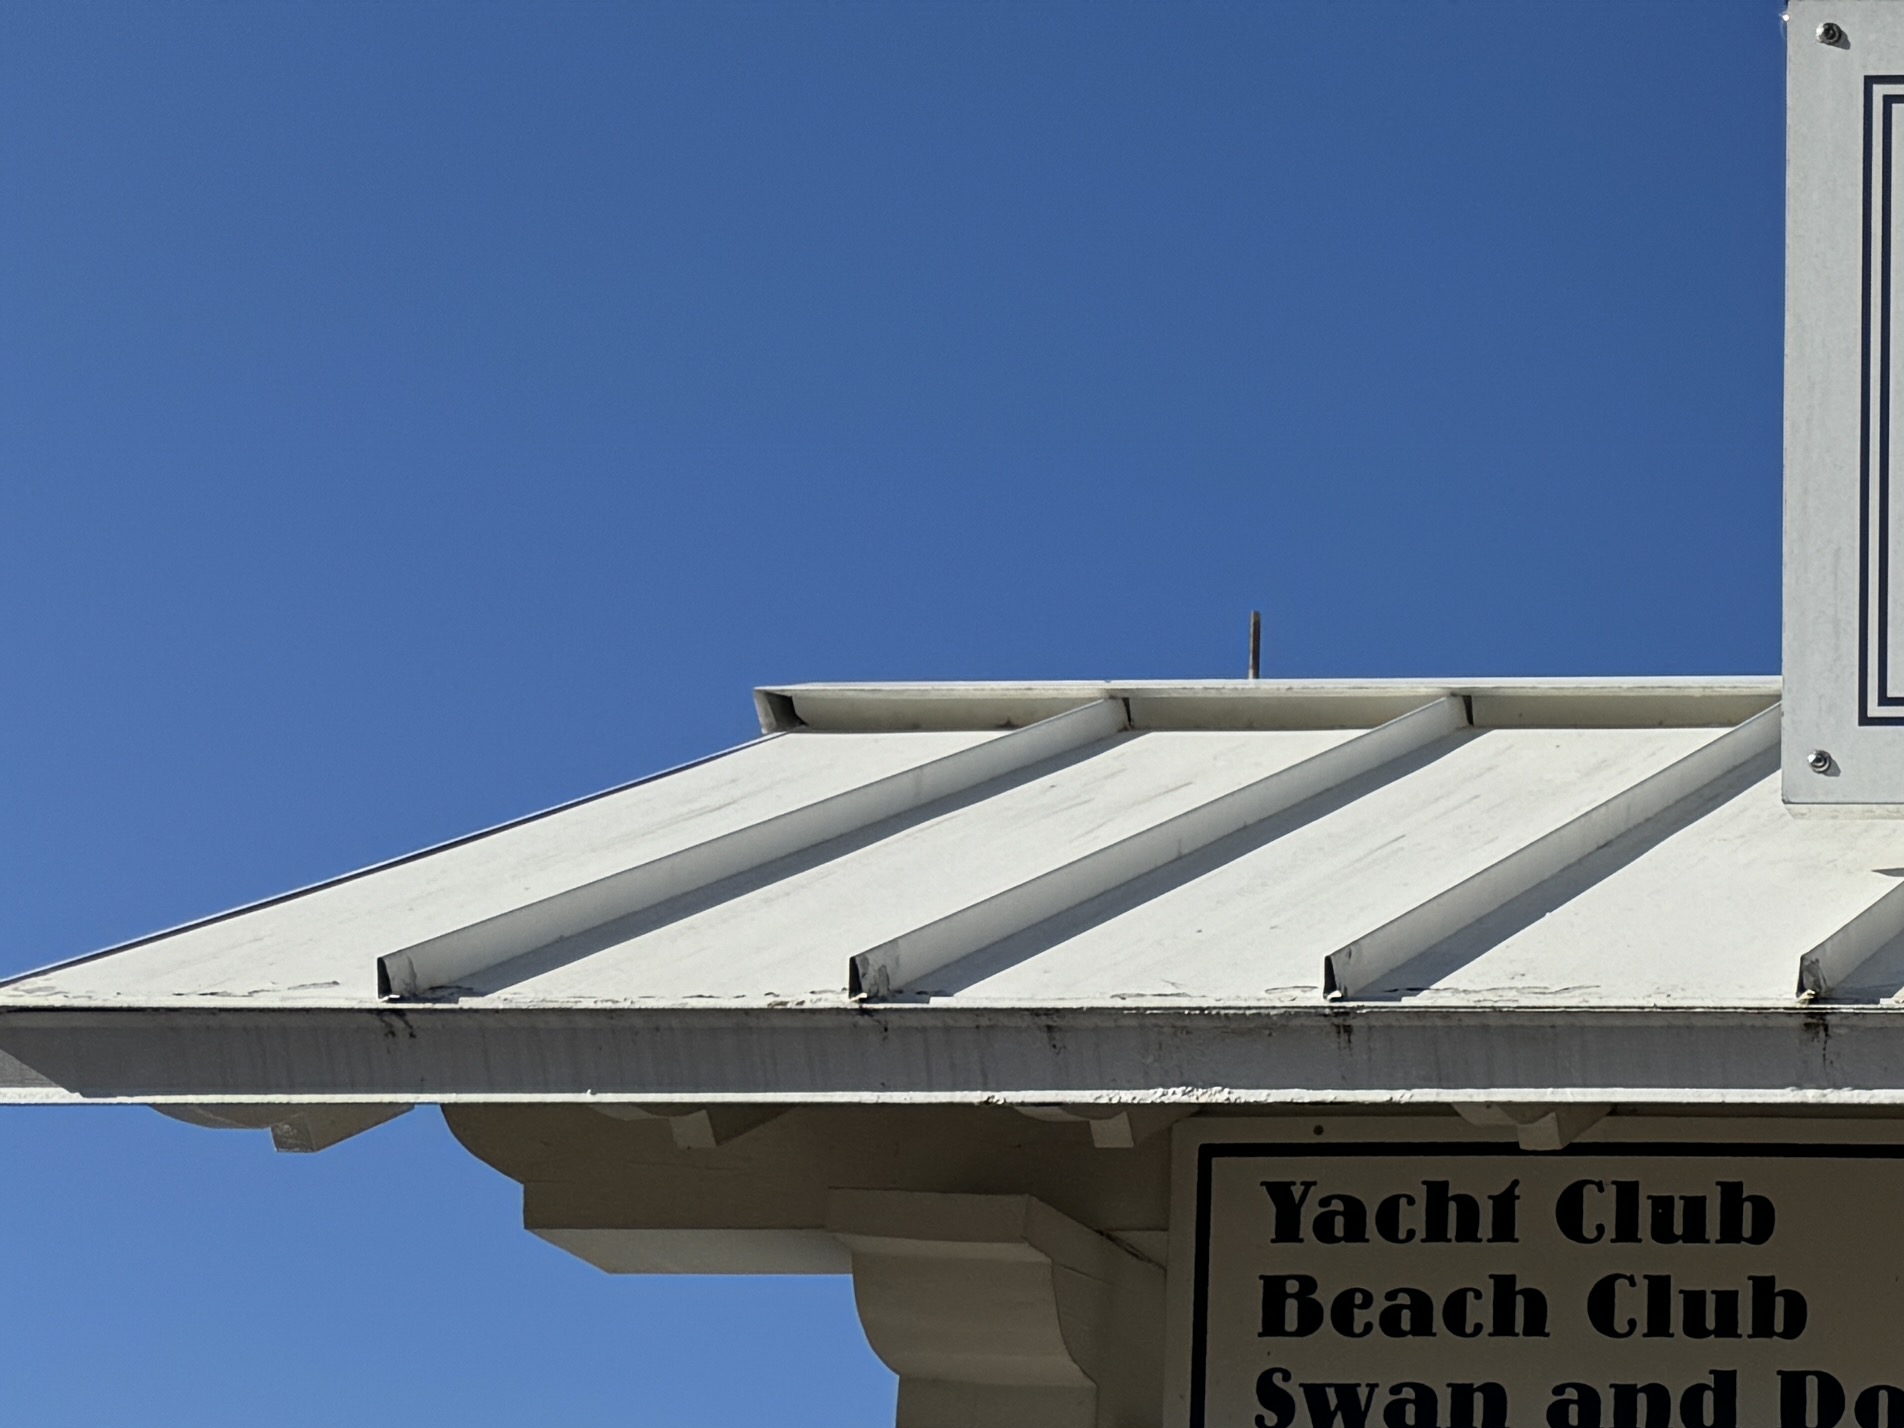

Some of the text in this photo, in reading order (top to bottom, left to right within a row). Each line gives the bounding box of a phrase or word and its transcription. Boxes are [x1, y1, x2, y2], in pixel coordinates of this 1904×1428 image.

[1260, 1179, 1775, 1245] Yacht Club
[1258, 1273, 1807, 1340] Beach Club
